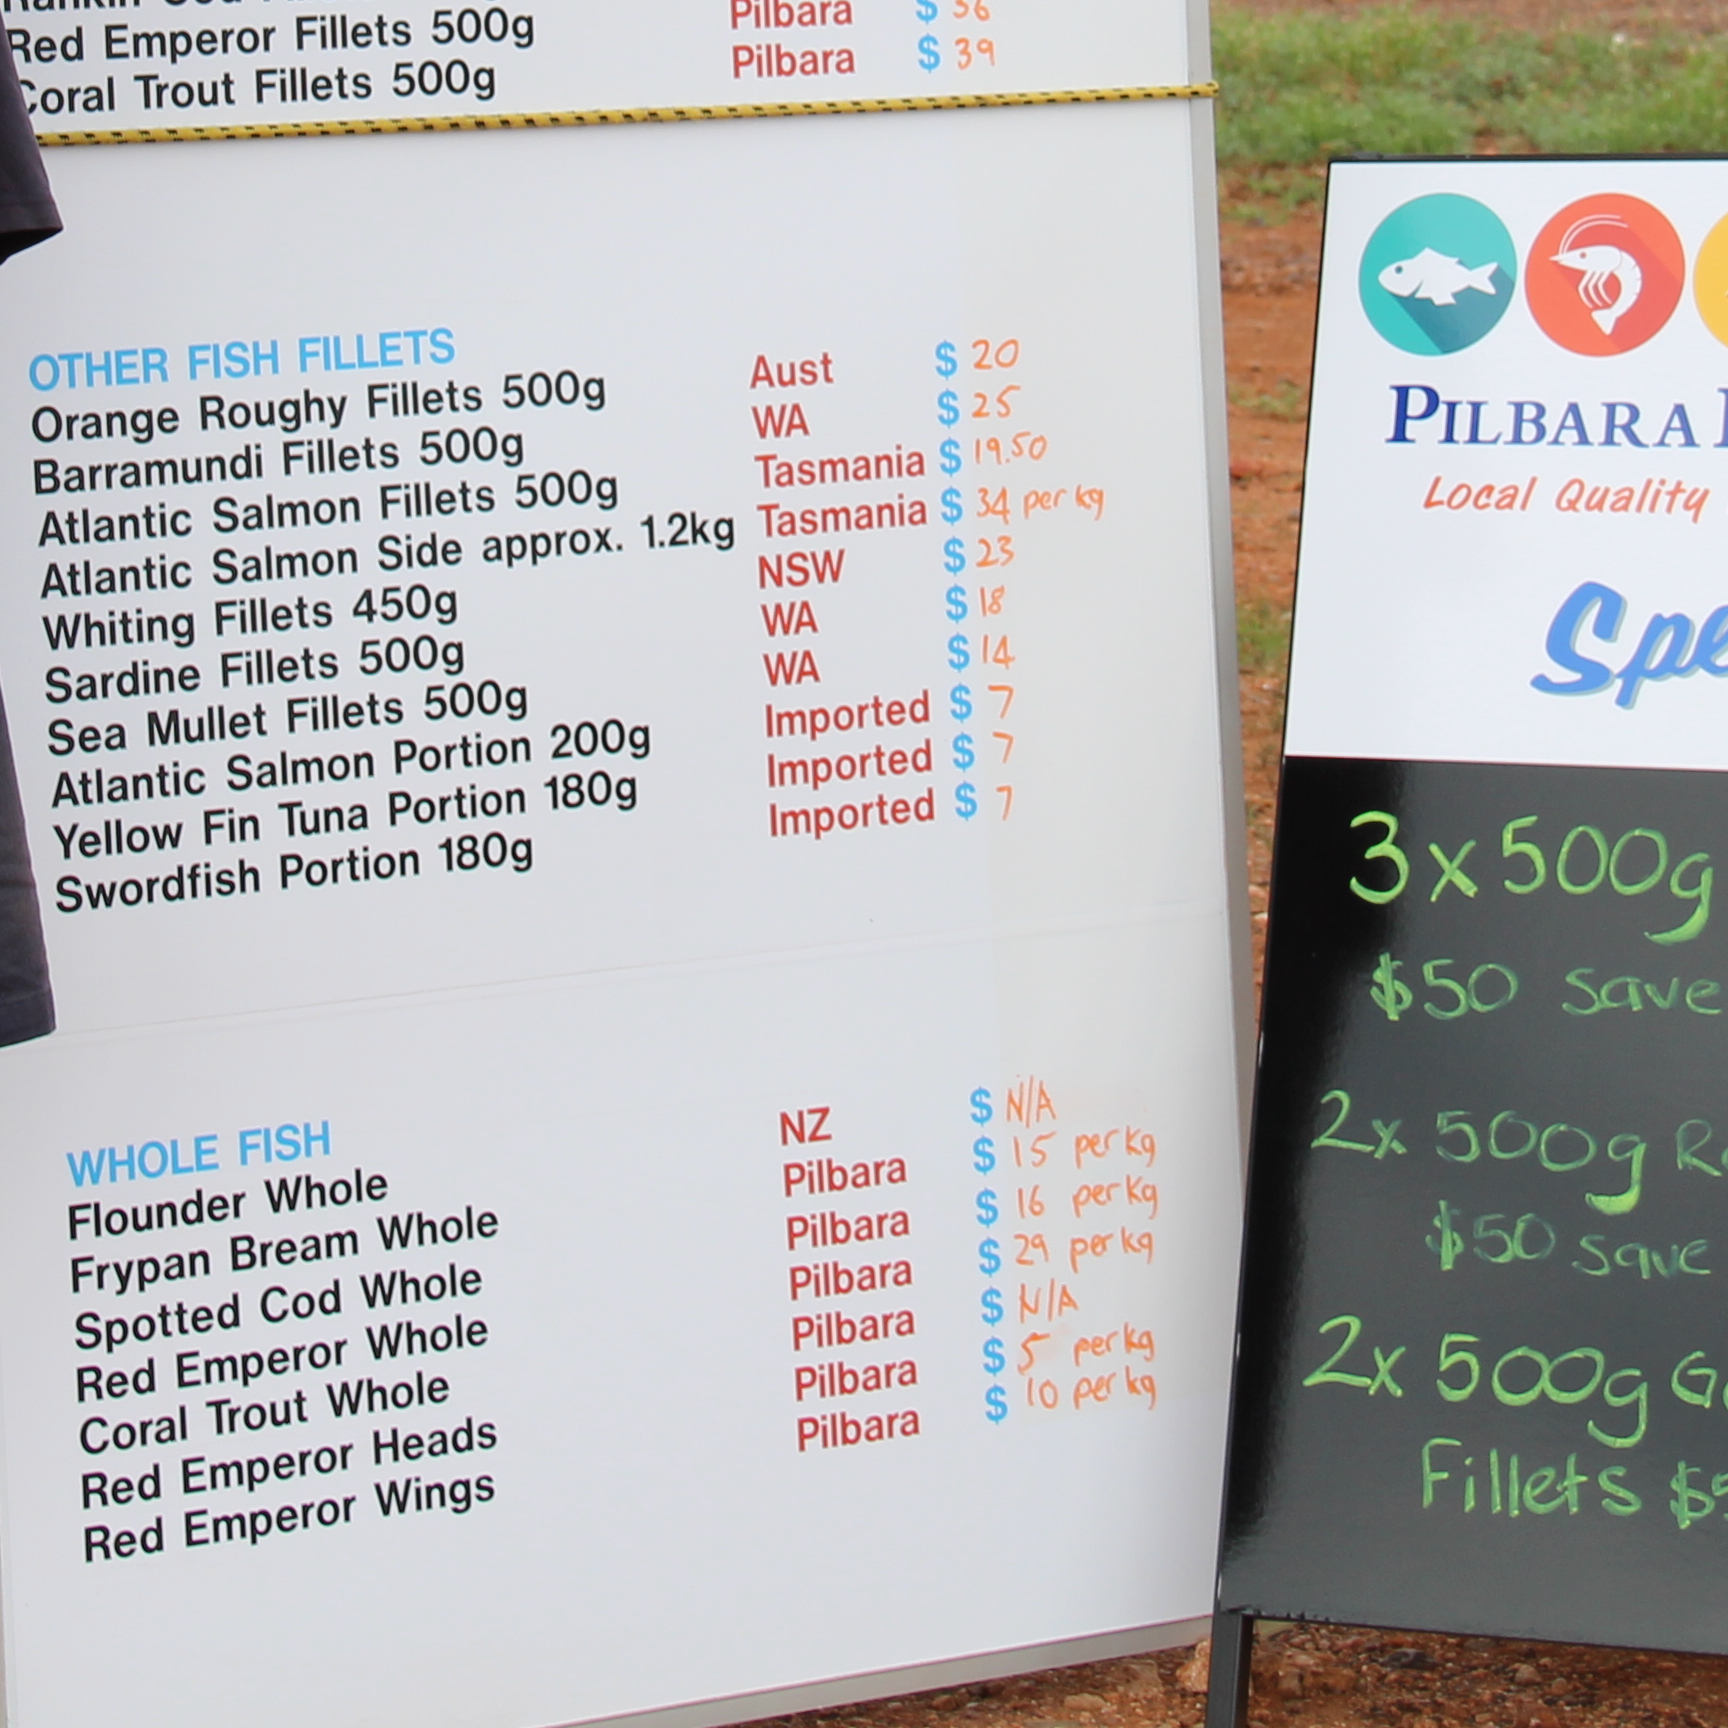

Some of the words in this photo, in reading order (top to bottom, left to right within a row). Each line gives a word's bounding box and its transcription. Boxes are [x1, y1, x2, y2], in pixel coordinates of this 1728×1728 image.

[27, 346, 171, 394] OTHER
[186, 338, 282, 383] FISH
[297, 326, 458, 375] FILLETS
[30, 405, 180, 445] Orange
[198, 388, 348, 434] Roughy
[366, 380, 483, 419] Fillets
[502, 369, 606, 412] 500g
[750, 352, 835, 389] Aust
[1385, 385, 1700, 450] PILBARA
[39, 553, 193, 600] Atlantic
[212, 545, 359, 586] Salmon
[377, 531, 463, 572] Side
[481, 527, 624, 569] approx.
[640, 511, 735, 552] 1.2kg
[756, 499, 928, 538] Tasmania
[1423, 476, 1538, 511] Local
[1555, 478, 1710, 523] Quality
[52, 818, 184, 861] Yellow
[202, 807, 261, 846] Fin
[276, 800, 369, 838] Tuna
[387, 783, 527, 827] Portion
[543, 770, 638, 812] 180g
[767, 737, 934, 791] Imported
[55, 858, 261, 914] Swordfish
[279, 845, 421, 890] Portion
[437, 831, 534, 874] 180g
[769, 786, 936, 840] Imported
[1500, 815, 1715, 945] 500g
[1368, 953, 1519, 1022] $50
[64, 1133, 222, 1190] WHOLE
[237, 1119, 333, 1168] FISH
[67, 1188, 247, 1242] Flounder
[263, 1167, 389, 1214] Whole
[779, 1105, 834, 1146] NZ
[1436, 1110, 1648, 1216] 500g
[70, 1249, 211, 1297] Frypan
[229, 1229, 360, 1272] Bream
[375, 1204, 499, 1252] Whole
[783, 1156, 908, 1198] Pilbara
[1425, 1200, 1556, 1275] $50
[74, 1292, 241, 1355] Spotted
[259, 1278, 342, 1324] Cod
[358, 1262, 483, 1310] Whole
[786, 1209, 911, 1251] Pilbara
[1435, 1332, 1651, 1448] 500g
[83, 1515, 165, 1564] Red
[183, 1495, 357, 1548] Emperor
[373, 1475, 496, 1517] Wings
[797, 1409, 921, 1452] Pilbara
[1421, 1436, 1643, 1519] Fillets
